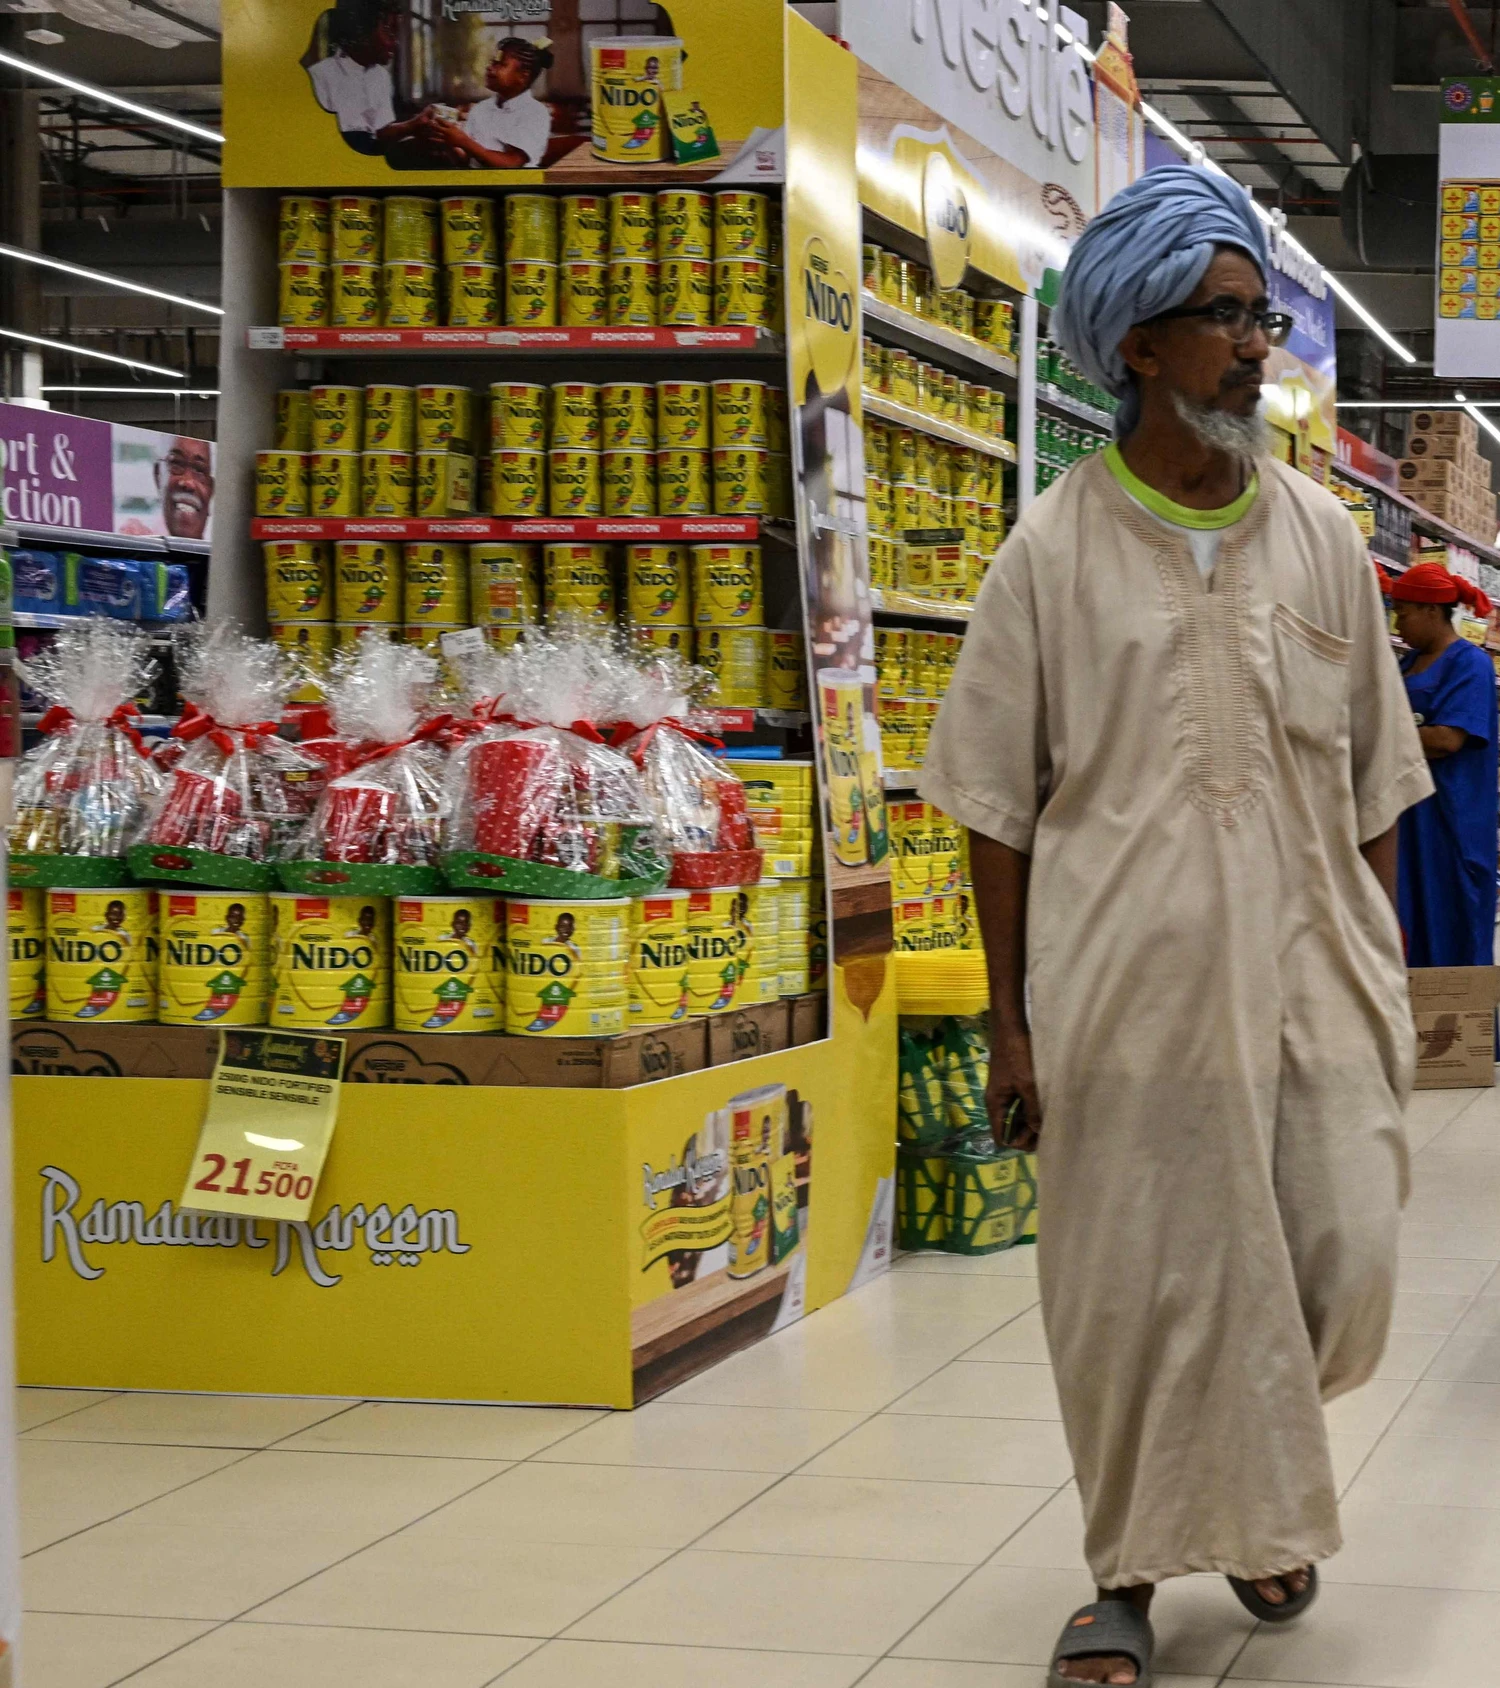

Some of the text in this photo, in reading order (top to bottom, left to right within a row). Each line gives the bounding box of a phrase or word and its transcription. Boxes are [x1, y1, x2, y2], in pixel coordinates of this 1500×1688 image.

[600, 87, 658, 106] NIDO
[672, 115, 706, 129] NIDO
[804, 269, 851, 333] NIDO
[339, 333, 402, 342] PROMOTION
[422, 333, 485, 342] PROMOTION
[520, 332, 570, 341] OMOTION
[591, 332, 655, 341] PROMOTION
[50, 433, 78, 482] &
[262, 524, 323, 533] PROMOTION
[345, 524, 406, 533] PROMOTION
[428, 524, 490, 533] PROMOTION
[512, 524, 575, 533] PROMOTION
[597, 524, 660, 533] PROMOTION
[682, 524, 745, 533] PROMOTION
[633, 571, 676, 586] NIDO
[709, 571, 752, 586] NIDO
[48, 938, 123, 962] NIDO
[166, 939, 243, 965] NIDO
[689, 933, 738, 960] NIDO
[292, 943, 374, 969] NIDO
[397, 945, 469, 972] NIDO
[506, 947, 572, 976] NIDO
[640, 942, 687, 969] NID
[251, 1075, 277, 1087] NIDO
[279, 1079, 333, 1094] FORTIFIED
[217, 1084, 320, 1106] SENSIBLE SENSIBLE
[273, 1161, 298, 1171] FCFA
